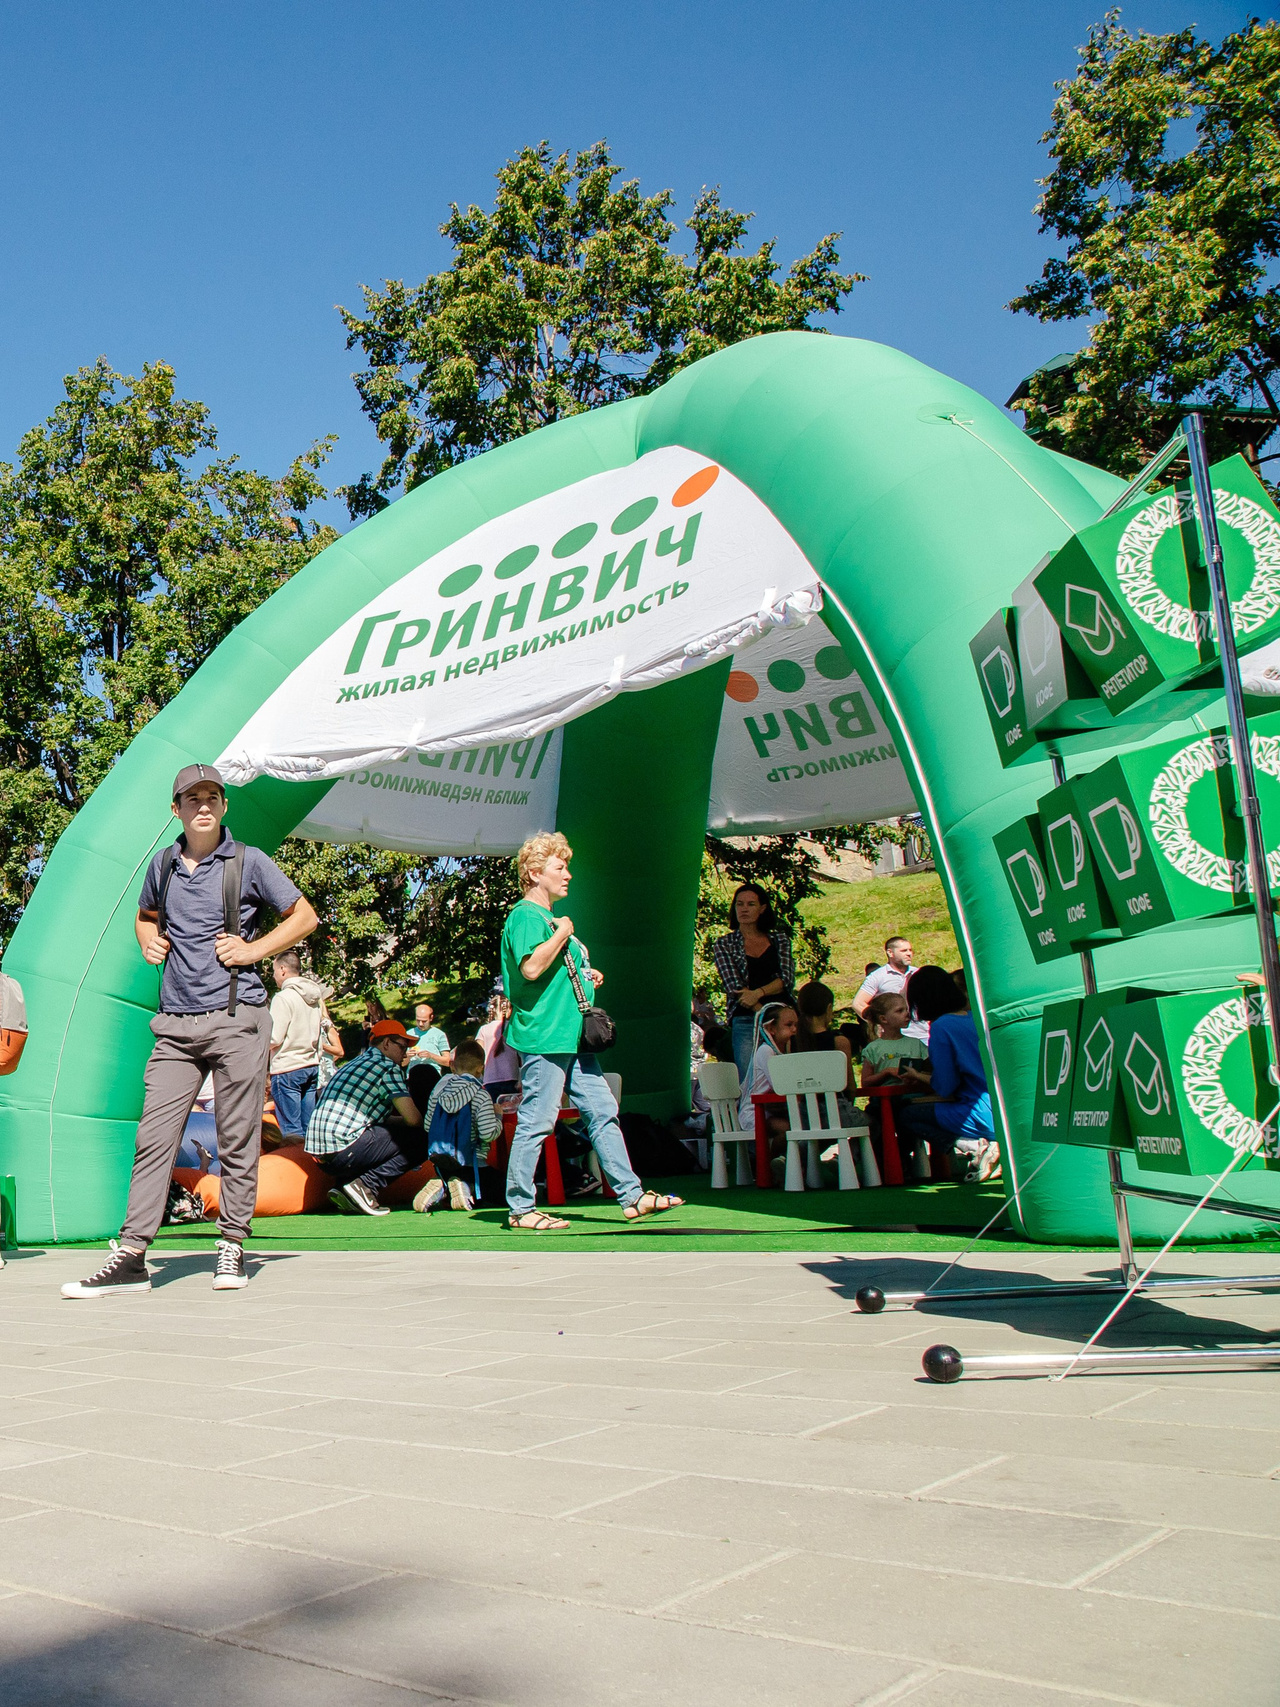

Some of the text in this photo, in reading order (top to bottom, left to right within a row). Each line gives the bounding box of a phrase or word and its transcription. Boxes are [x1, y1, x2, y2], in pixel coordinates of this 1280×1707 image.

[335, 580, 690, 704] жилая недвижимость
[1100, 653, 1149, 699] РЕПЕТИТОР
[1035, 681, 1054, 709] КОФЕ
[1004, 723, 1023, 747] КОФЕ
[1066, 902, 1087, 924] КОФЕ
[1126, 893, 1153, 916] КОФЕ
[1037, 928, 1057, 947] КОФЕ
[1042, 1112, 1059, 1127] КОФЕ
[1072, 1110, 1110, 1127] РЕПЕТИТОР
[1136, 1136, 1182, 1155] РЕПЕТИТОР
